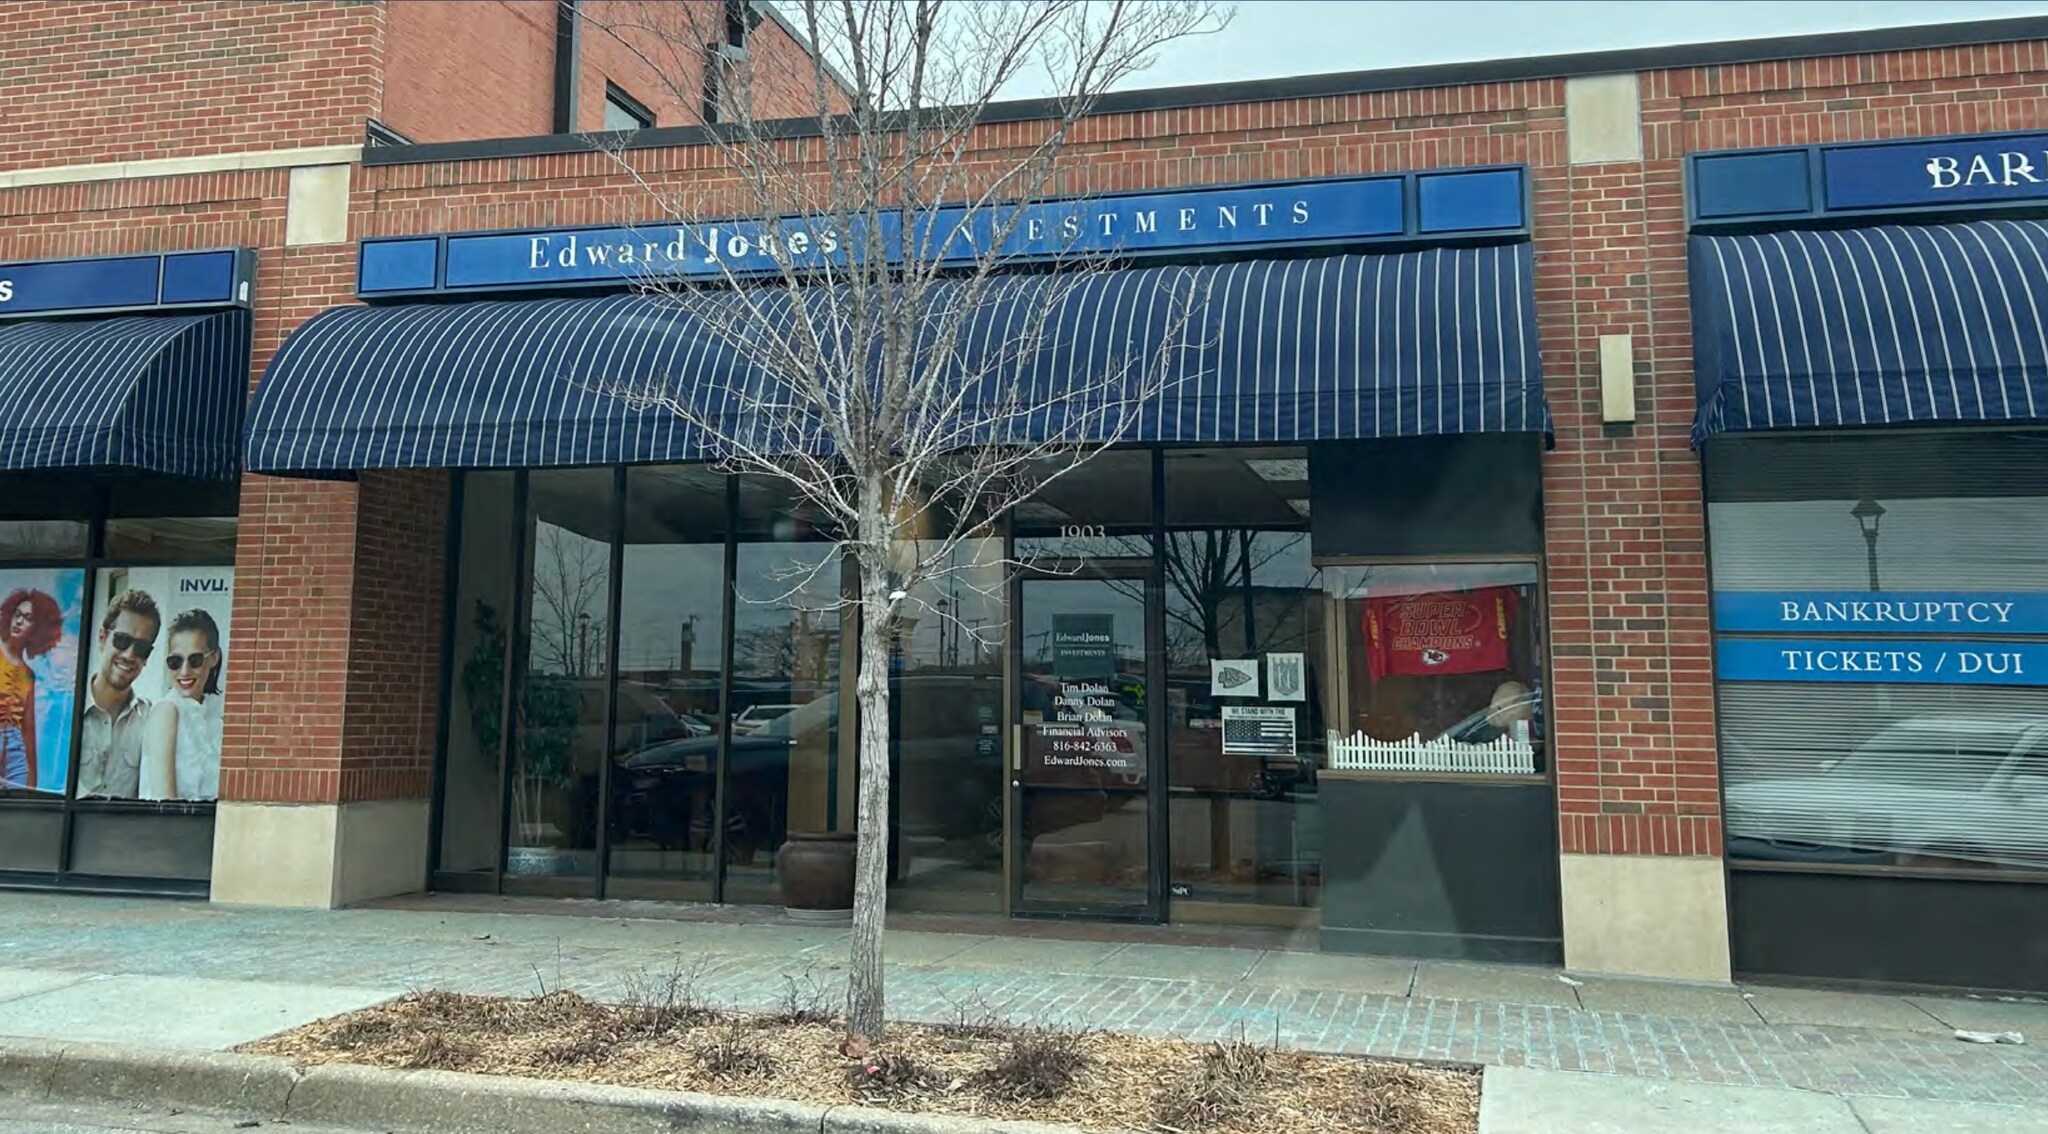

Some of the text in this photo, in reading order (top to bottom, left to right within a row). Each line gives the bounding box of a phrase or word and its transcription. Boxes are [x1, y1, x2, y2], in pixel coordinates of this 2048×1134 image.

[1926, 150, 2048, 188] BAR
[928, 200, 1310, 246] ESTMENTS
[528, 227, 838, 270] Edward Jones
[1059, 524, 1106, 541] 1903
[1400, 601, 1466, 620] SUPER
[1780, 601, 2015, 623] BANKRUPTCY
[1400, 618, 1462, 636] BOWL
[1392, 635, 1474, 651] CHAMPIONS
[1782, 651, 1923, 673] TICKETS
[1958, 652, 2024, 674] DUI
[1060, 682, 1109, 693] Tim Dolan
[1054, 696, 1115, 708] Danny Dolan
[1057, 711, 1112, 723] Brian Dolan
[1043, 726, 1128, 738] Financial Advisors
[1053, 741, 1117, 752] 816-842-6363
[1044, 755, 1127, 767] EdwardJones.com
